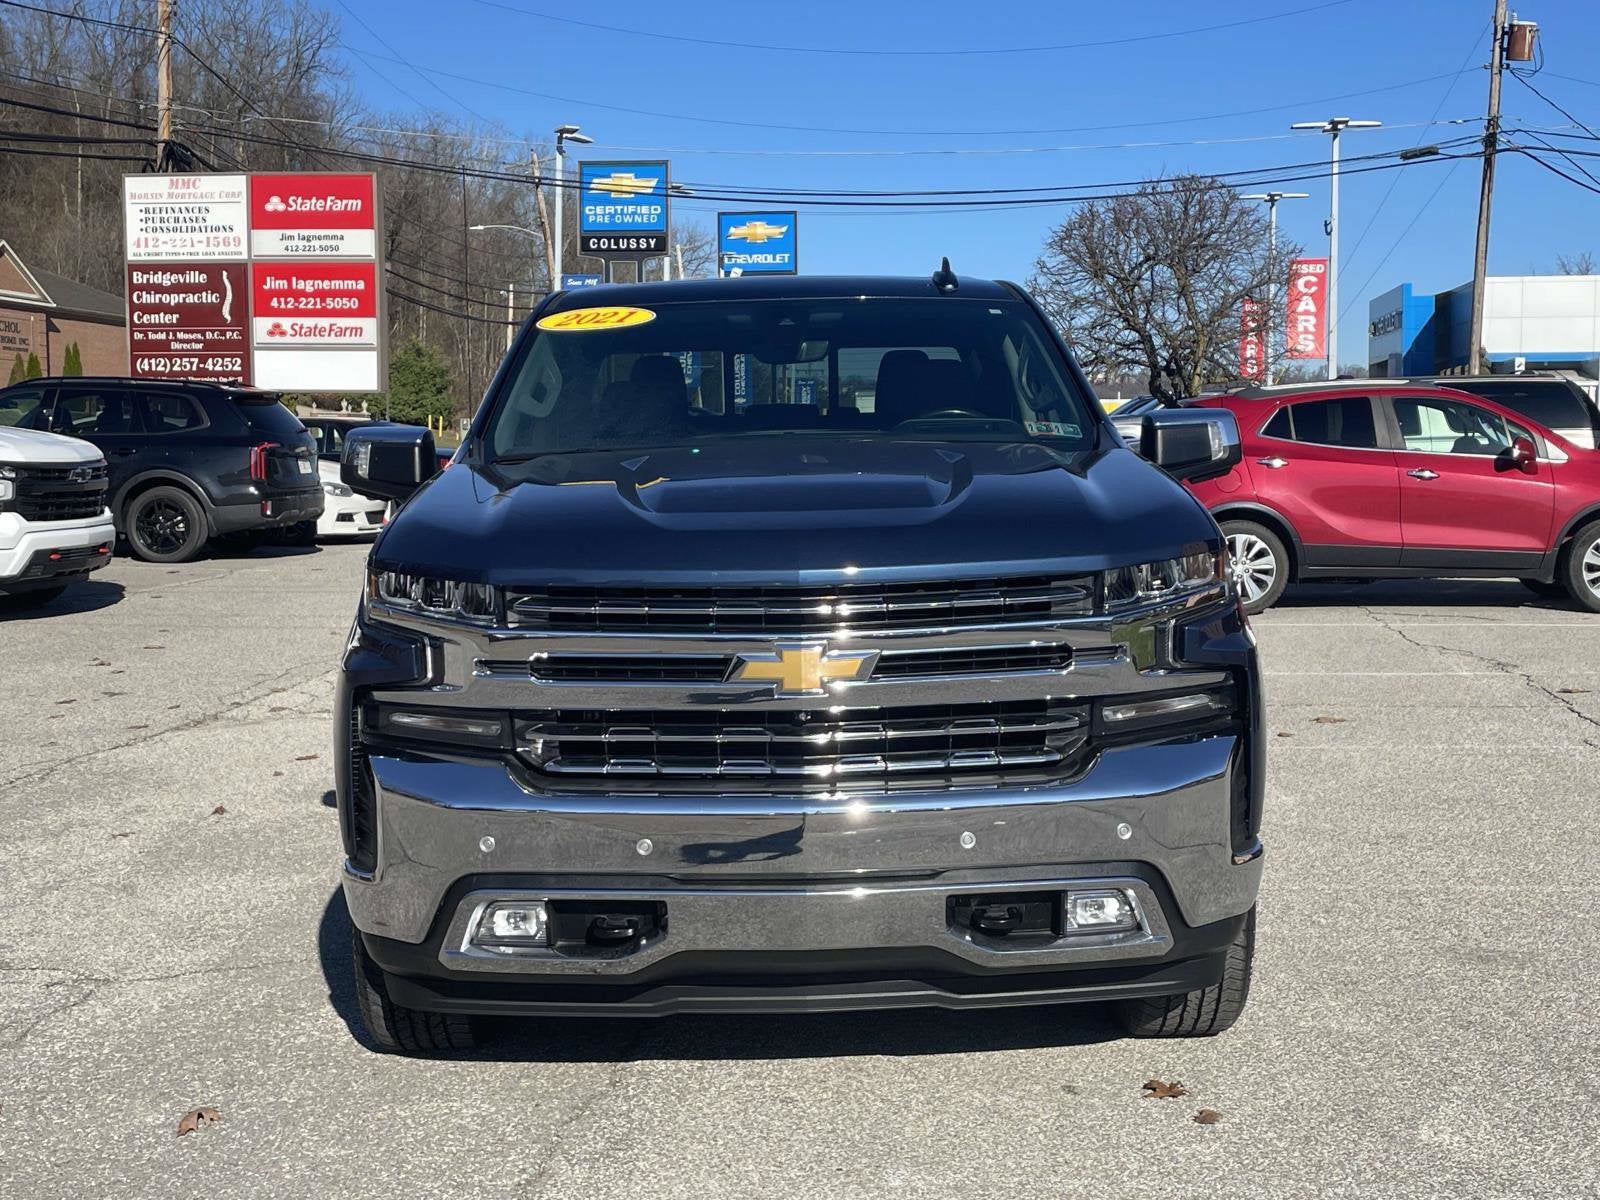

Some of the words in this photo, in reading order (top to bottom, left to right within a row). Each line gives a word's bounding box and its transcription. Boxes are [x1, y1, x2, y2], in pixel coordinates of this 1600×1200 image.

[168, 178, 201, 190] MMC
[166, 191, 216, 200] MORTGAGE
[144, 206, 210, 215] REFINANCES
[585, 205, 662, 215] CERTIFIED
[144, 216, 207, 224] PURCHASES
[588, 214, 658, 223] PRE-OWNED
[144, 225, 234, 234] CONSOLIDATIONS
[280, 232, 296, 241] Jim
[133, 236, 242, 249] 412-221-1569
[589, 238, 657, 249] COLUSSY
[284, 244, 340, 252] 412-221-5050
[132, 270, 207, 286] Bridgeville
[262, 276, 288, 290] Jim
[291, 276, 366, 293] Iagnemma
[132, 290, 220, 306] Chiropractic
[270, 297, 359, 309] 412-221-5050
[133, 311, 180, 324] Center
[1296, 275, 1318, 352] CARS
[554, 311, 638, 327] 2021
[133, 331, 146, 340] Dr.
[147, 331, 167, 340] Todd
[168, 331, 176, 340] J.
[176, 331, 204, 340] Moses,
[226, 331, 242, 340] P.C.
[171, 341, 204, 350] Director
